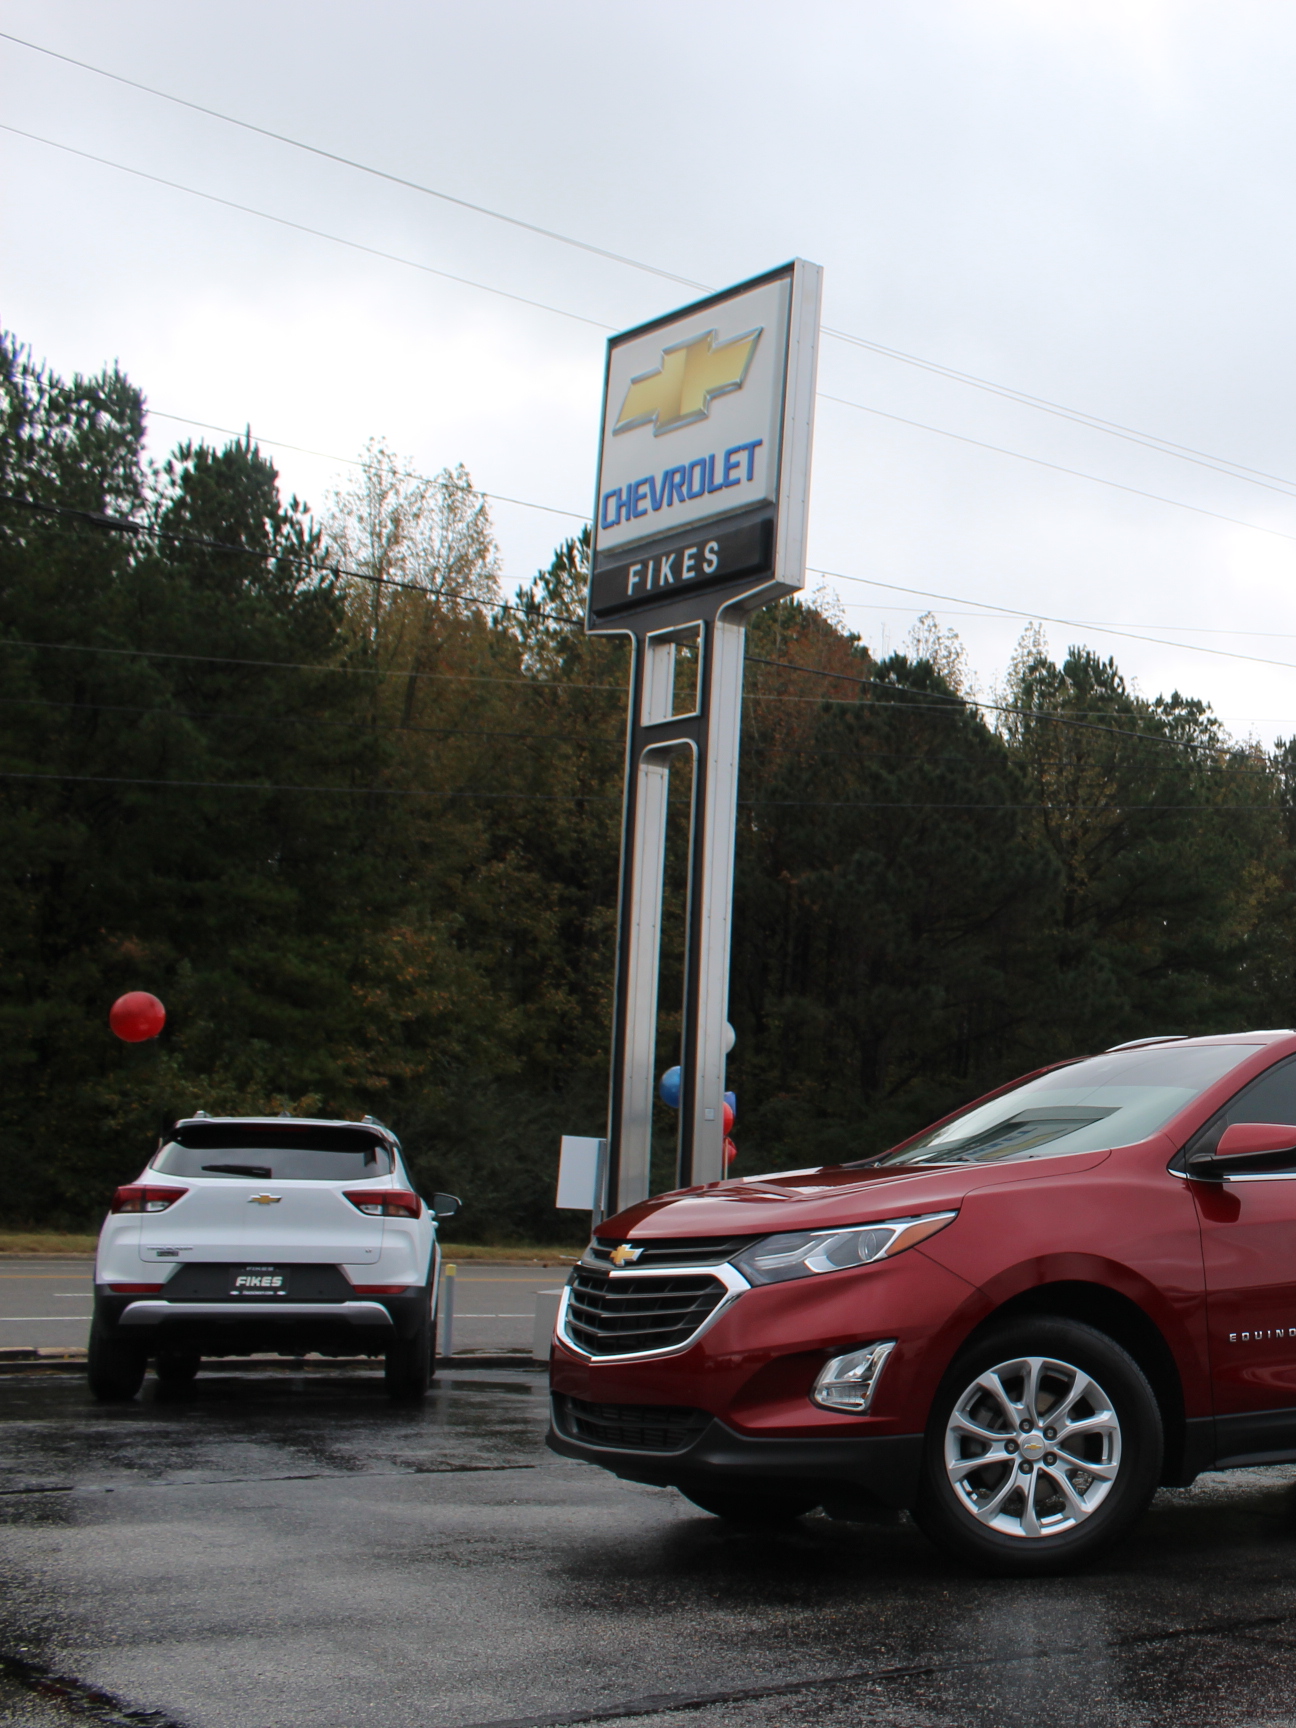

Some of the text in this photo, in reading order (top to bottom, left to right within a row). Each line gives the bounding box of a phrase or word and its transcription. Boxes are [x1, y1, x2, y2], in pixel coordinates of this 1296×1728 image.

[600, 437, 763, 530] CHEVROLET
[627, 540, 720, 596] FIKES
[235, 1276, 283, 1287] FIKES
